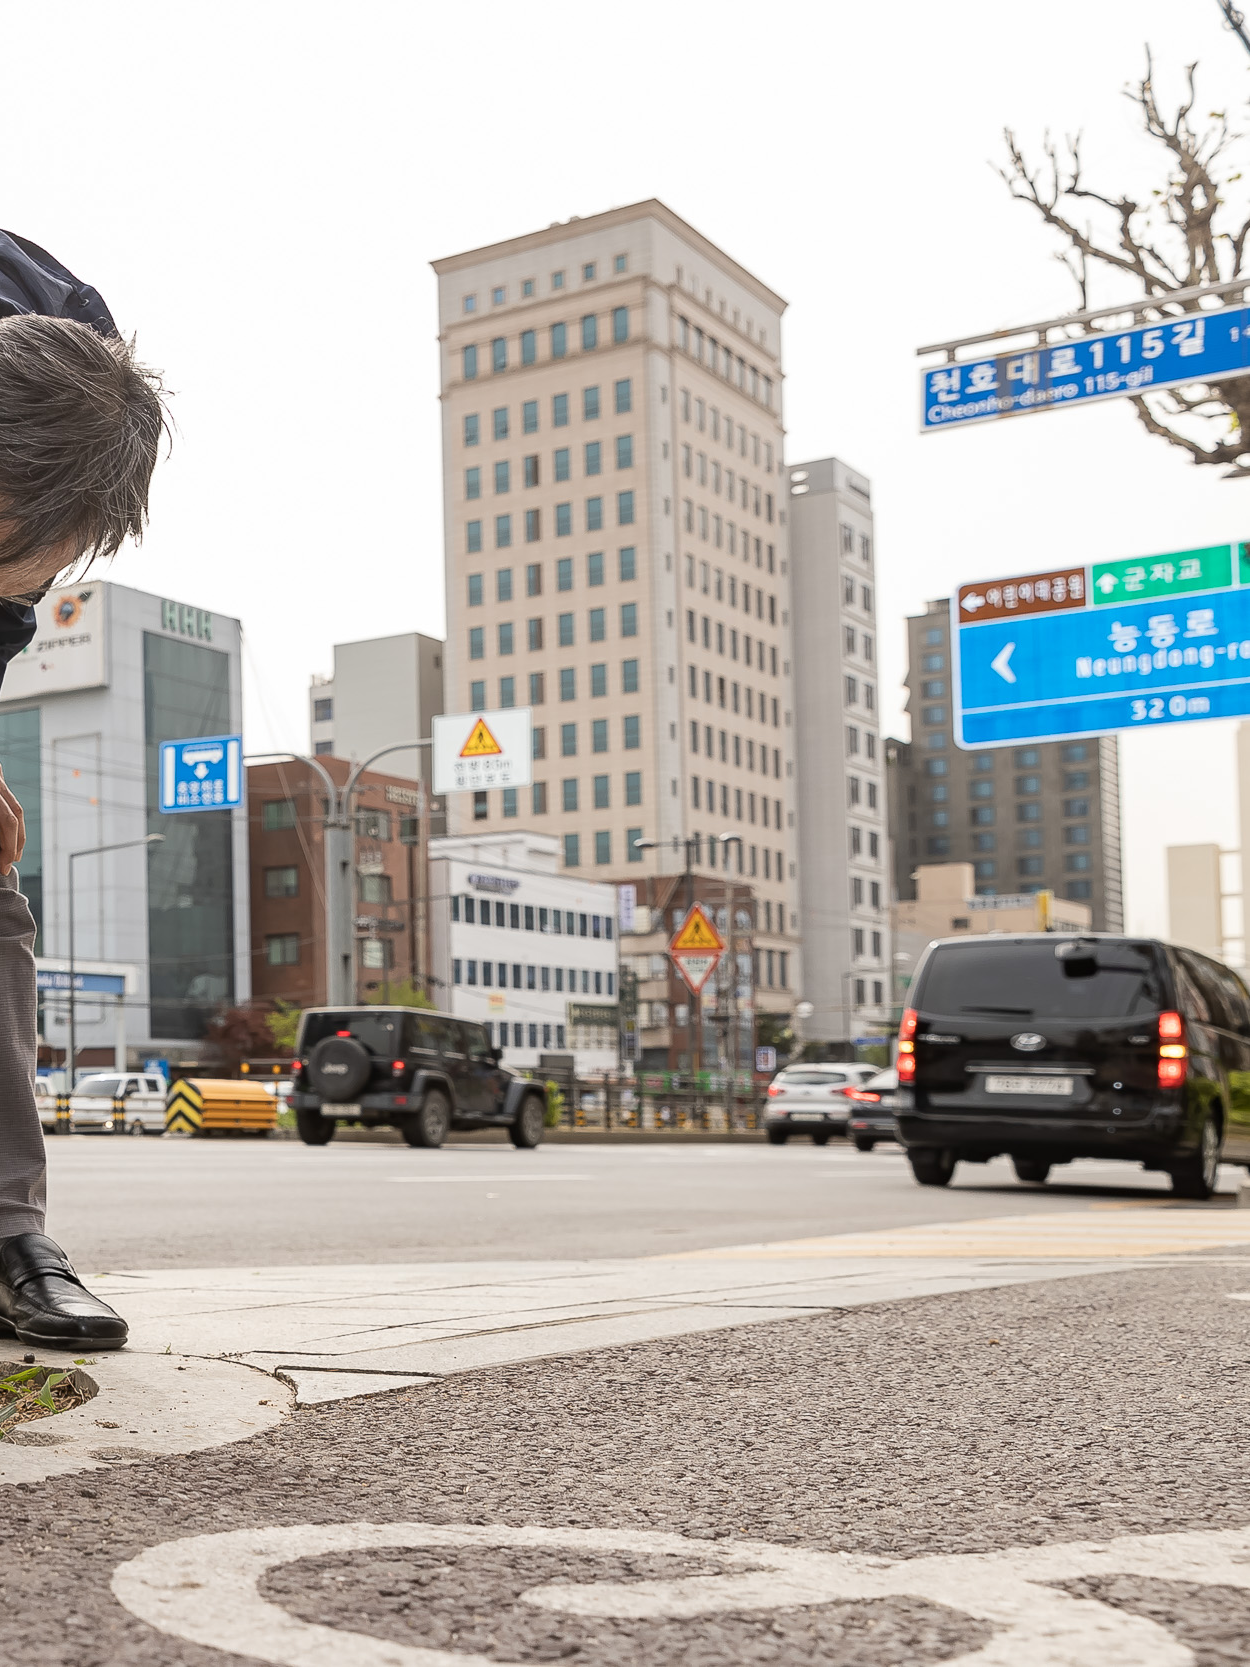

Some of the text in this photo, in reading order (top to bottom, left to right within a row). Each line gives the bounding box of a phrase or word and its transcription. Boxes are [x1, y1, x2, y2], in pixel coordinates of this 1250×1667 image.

[930, 318, 1205, 402] 천호대로115길
[928, 365, 1154, 423] Cheonho-daero 115-gil
[1122, 558, 1202, 591] 군자교
[1107, 608, 1219, 652] 능동로
[1130, 695, 1210, 721] 320m
